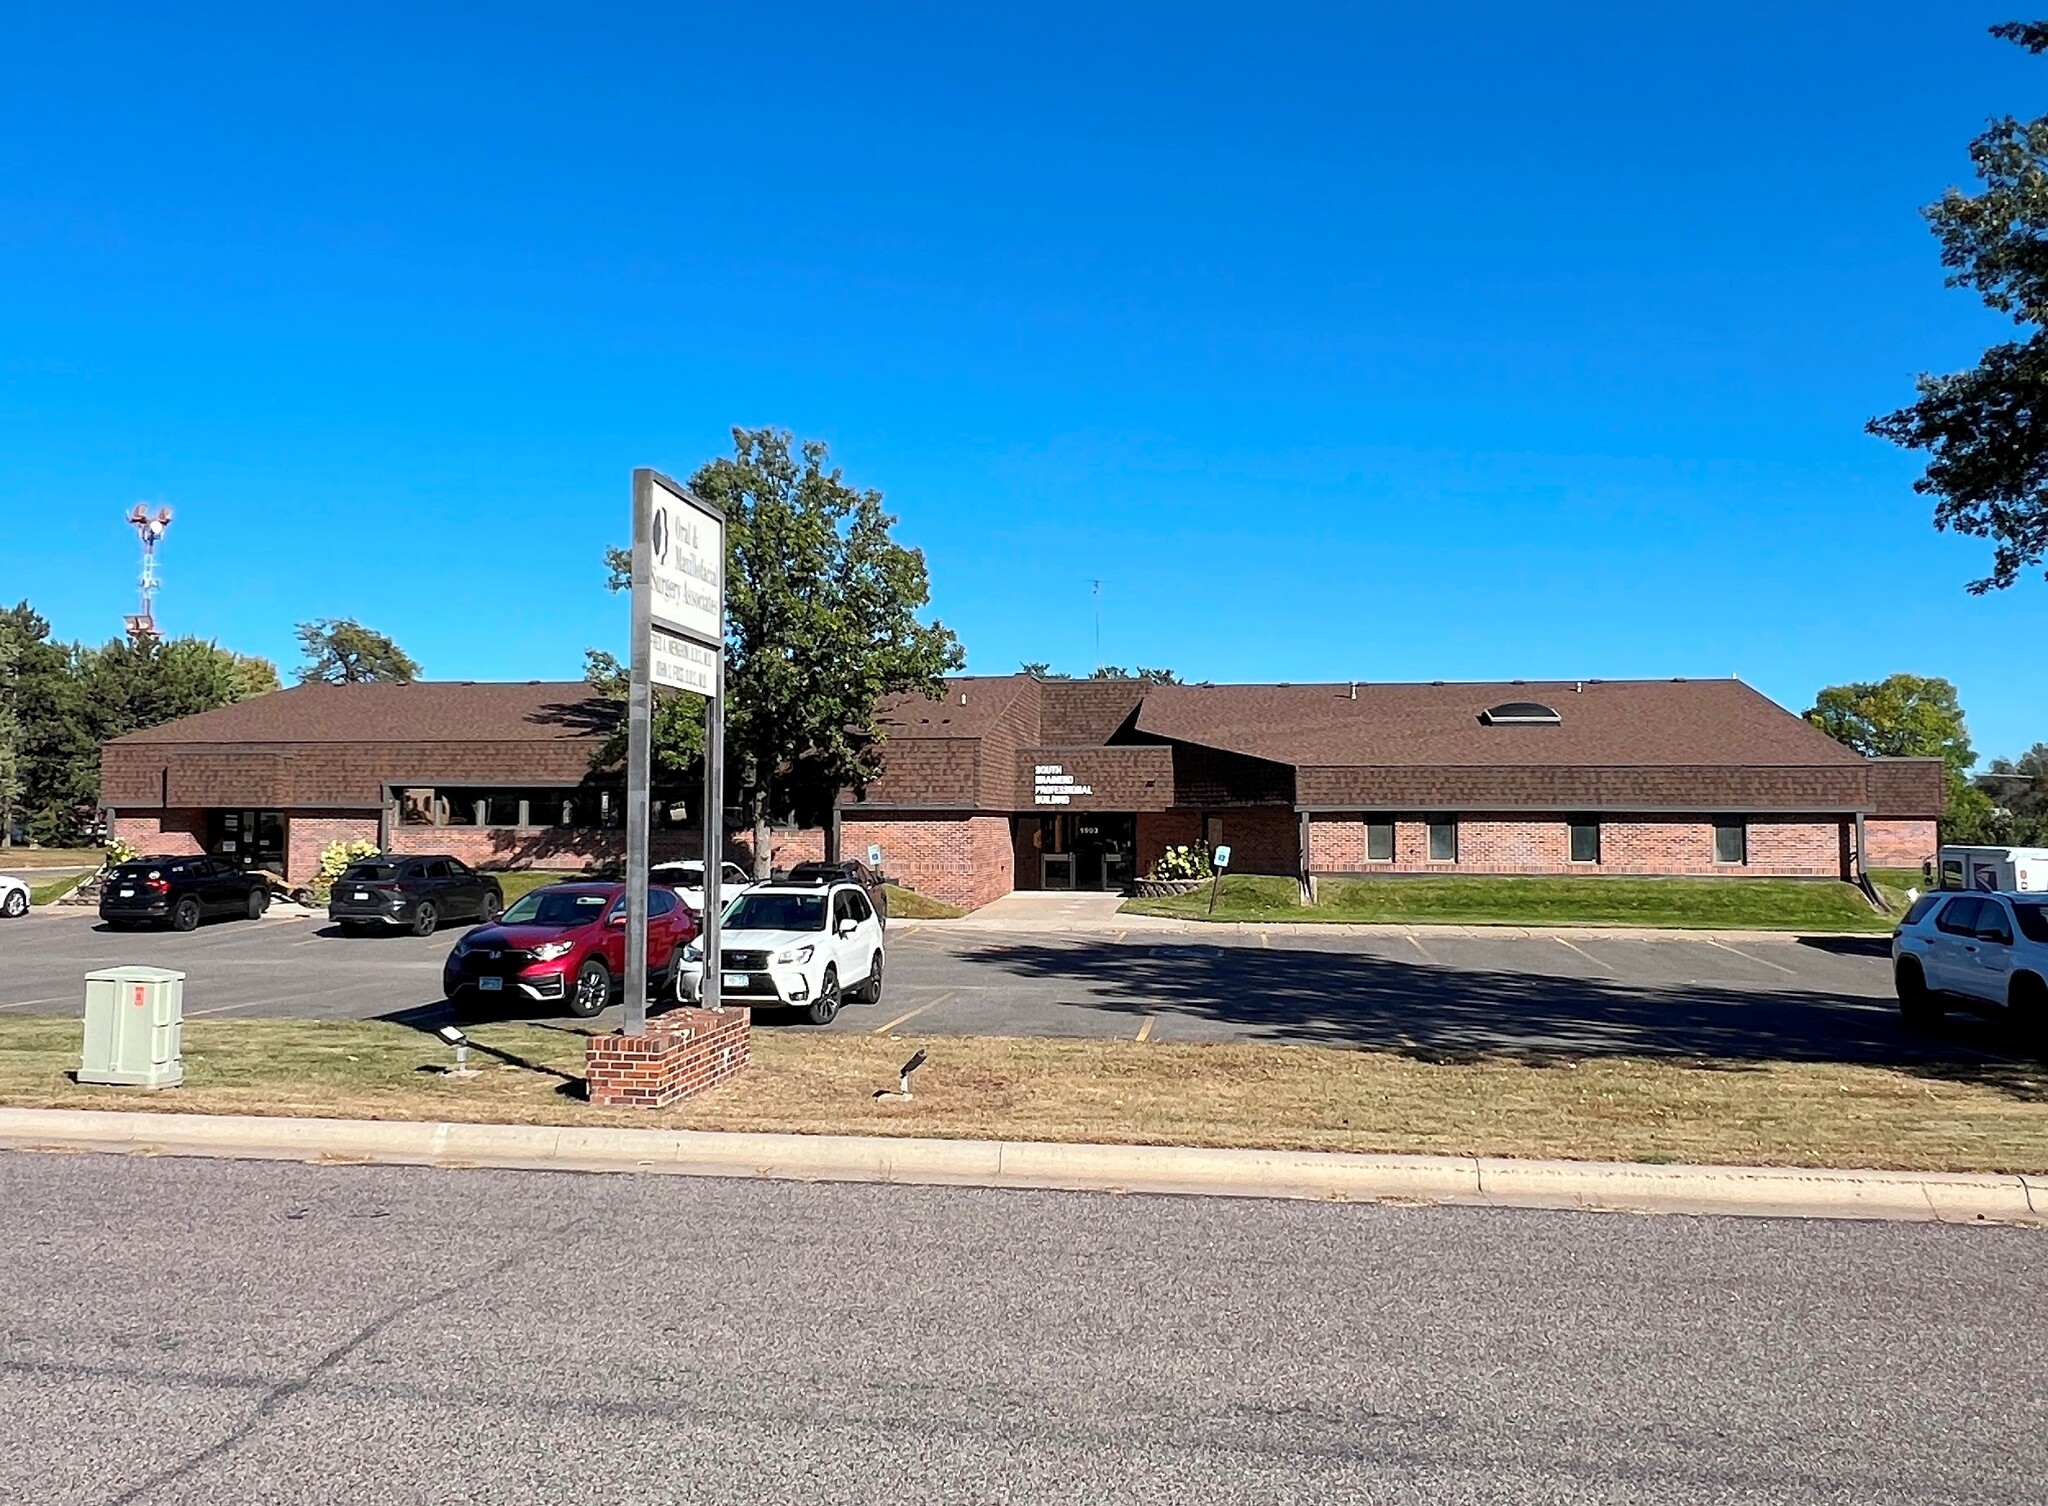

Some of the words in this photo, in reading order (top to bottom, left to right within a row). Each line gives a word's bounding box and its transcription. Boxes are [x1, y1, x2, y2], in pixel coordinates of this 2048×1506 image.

[675, 515, 690, 546] Oral
[651, 566, 681, 607] Surgery
[683, 580, 718, 616] Associates
[1035, 765, 1062, 775] SOUTH
[1035, 785, 1094, 795] PROFESSIONAL
[1035, 795, 1071, 805] BUILDING
